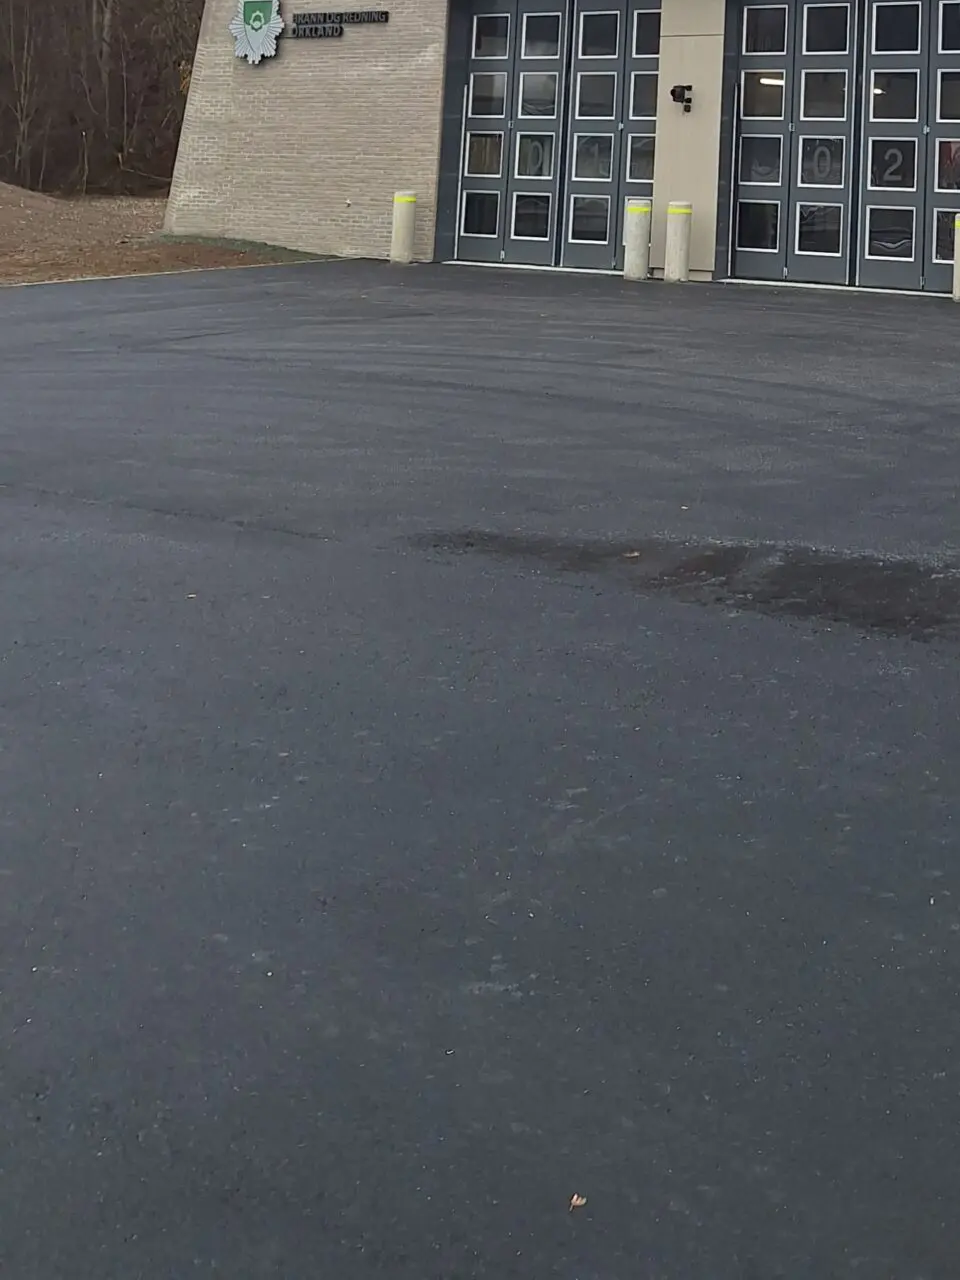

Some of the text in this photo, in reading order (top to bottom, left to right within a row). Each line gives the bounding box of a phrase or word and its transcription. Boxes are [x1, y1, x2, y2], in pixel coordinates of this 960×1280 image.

[293, 10, 386, 25] BRANN OG REDNING
[292, 24, 342, 37] ORKLAND
